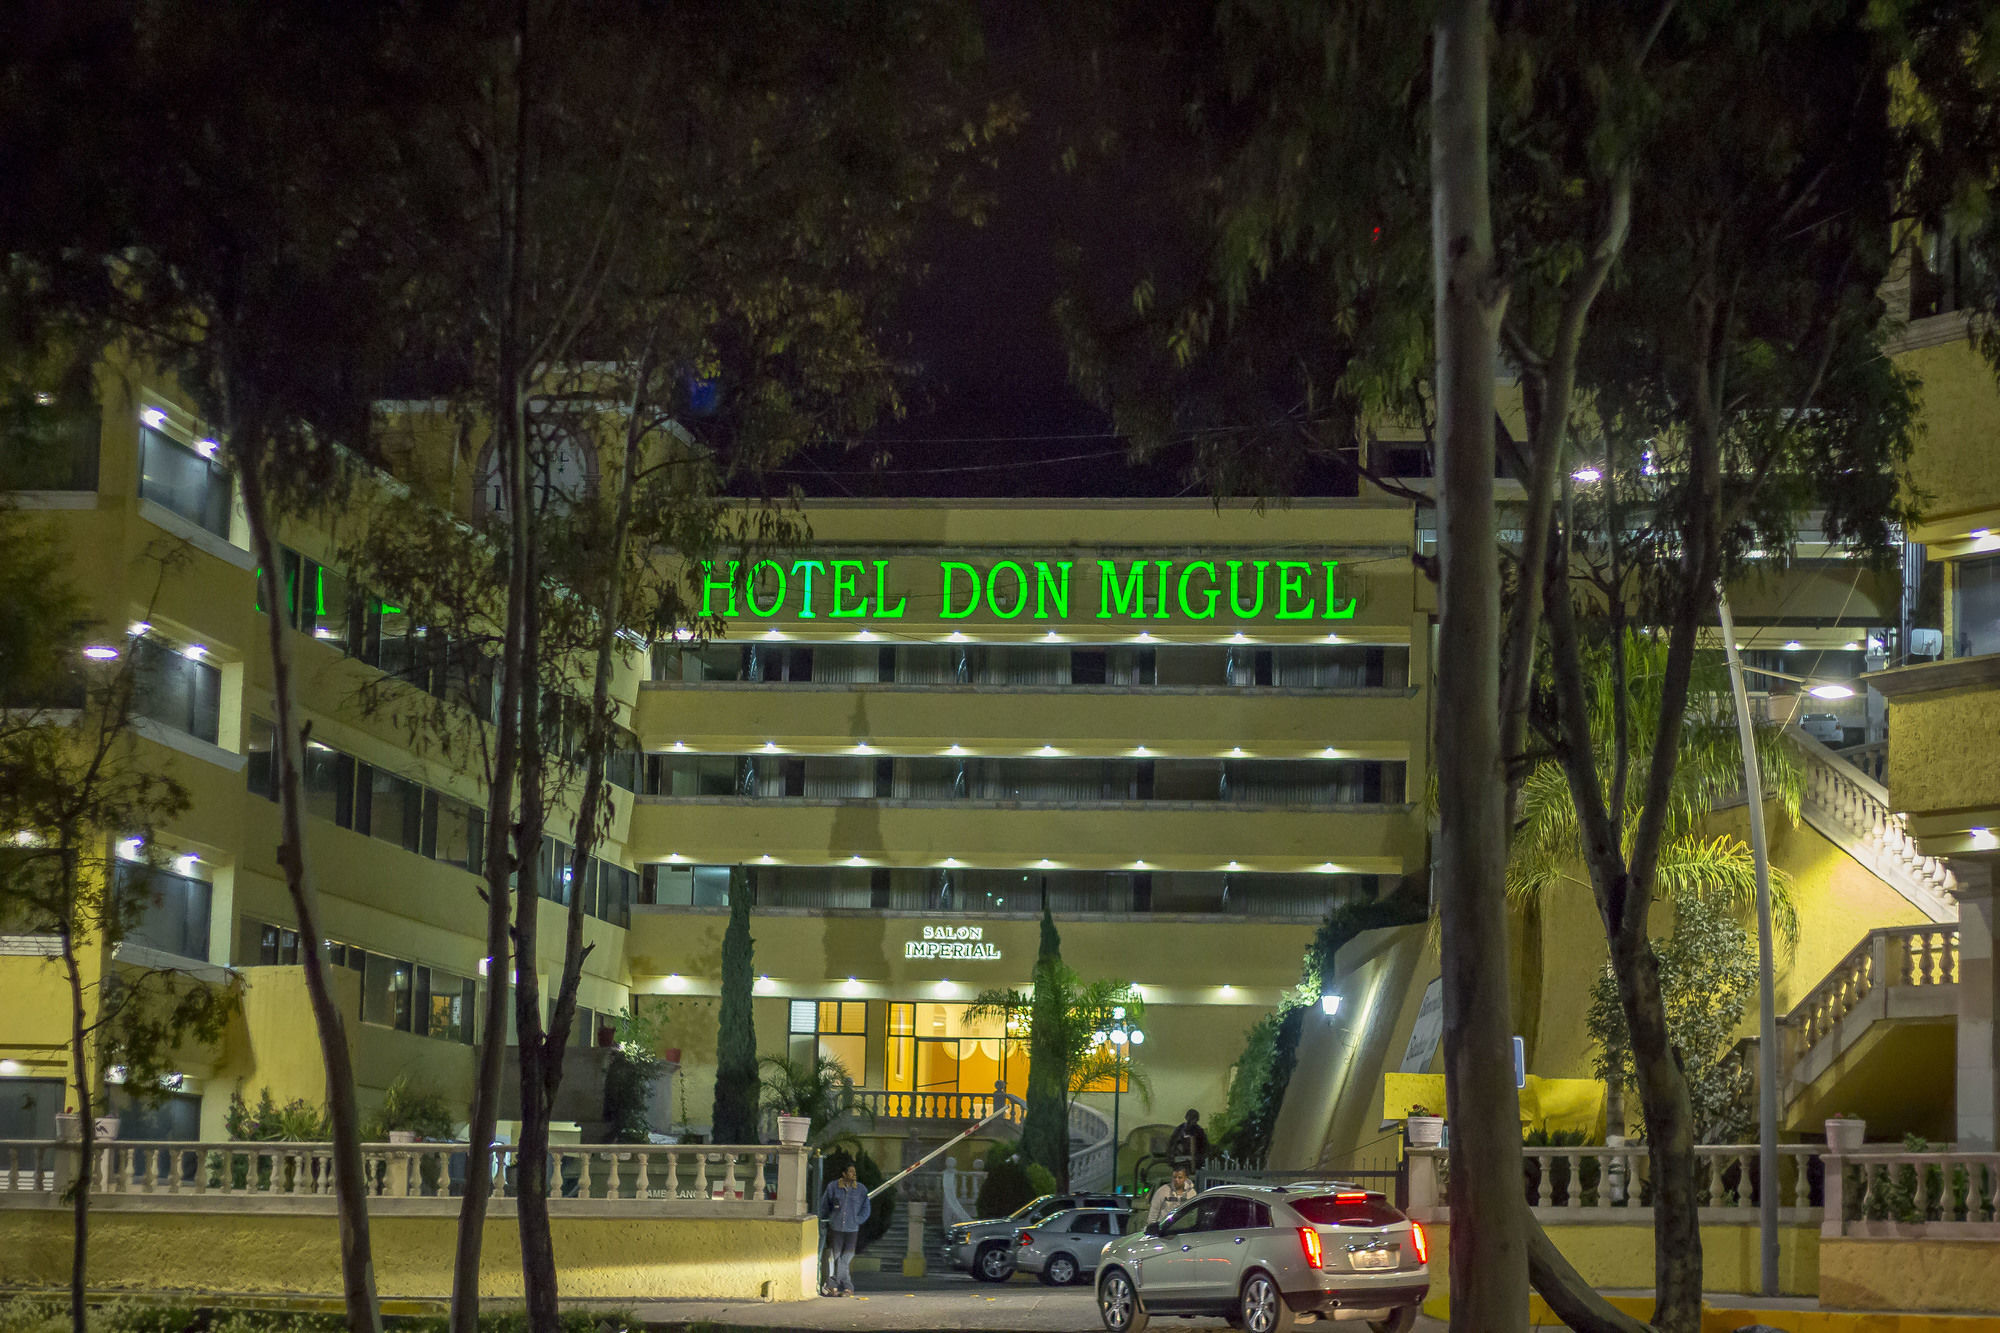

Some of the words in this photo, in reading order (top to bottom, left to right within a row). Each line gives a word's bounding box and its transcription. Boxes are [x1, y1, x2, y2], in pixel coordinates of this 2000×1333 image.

[697, 559, 907, 618] HOTEL
[938, 560, 1074, 620] DON
[1095, 559, 1357, 620] MIGUEL
[923, 926, 983, 940] SALON
[905, 942, 1001, 960] IMPERIAL
